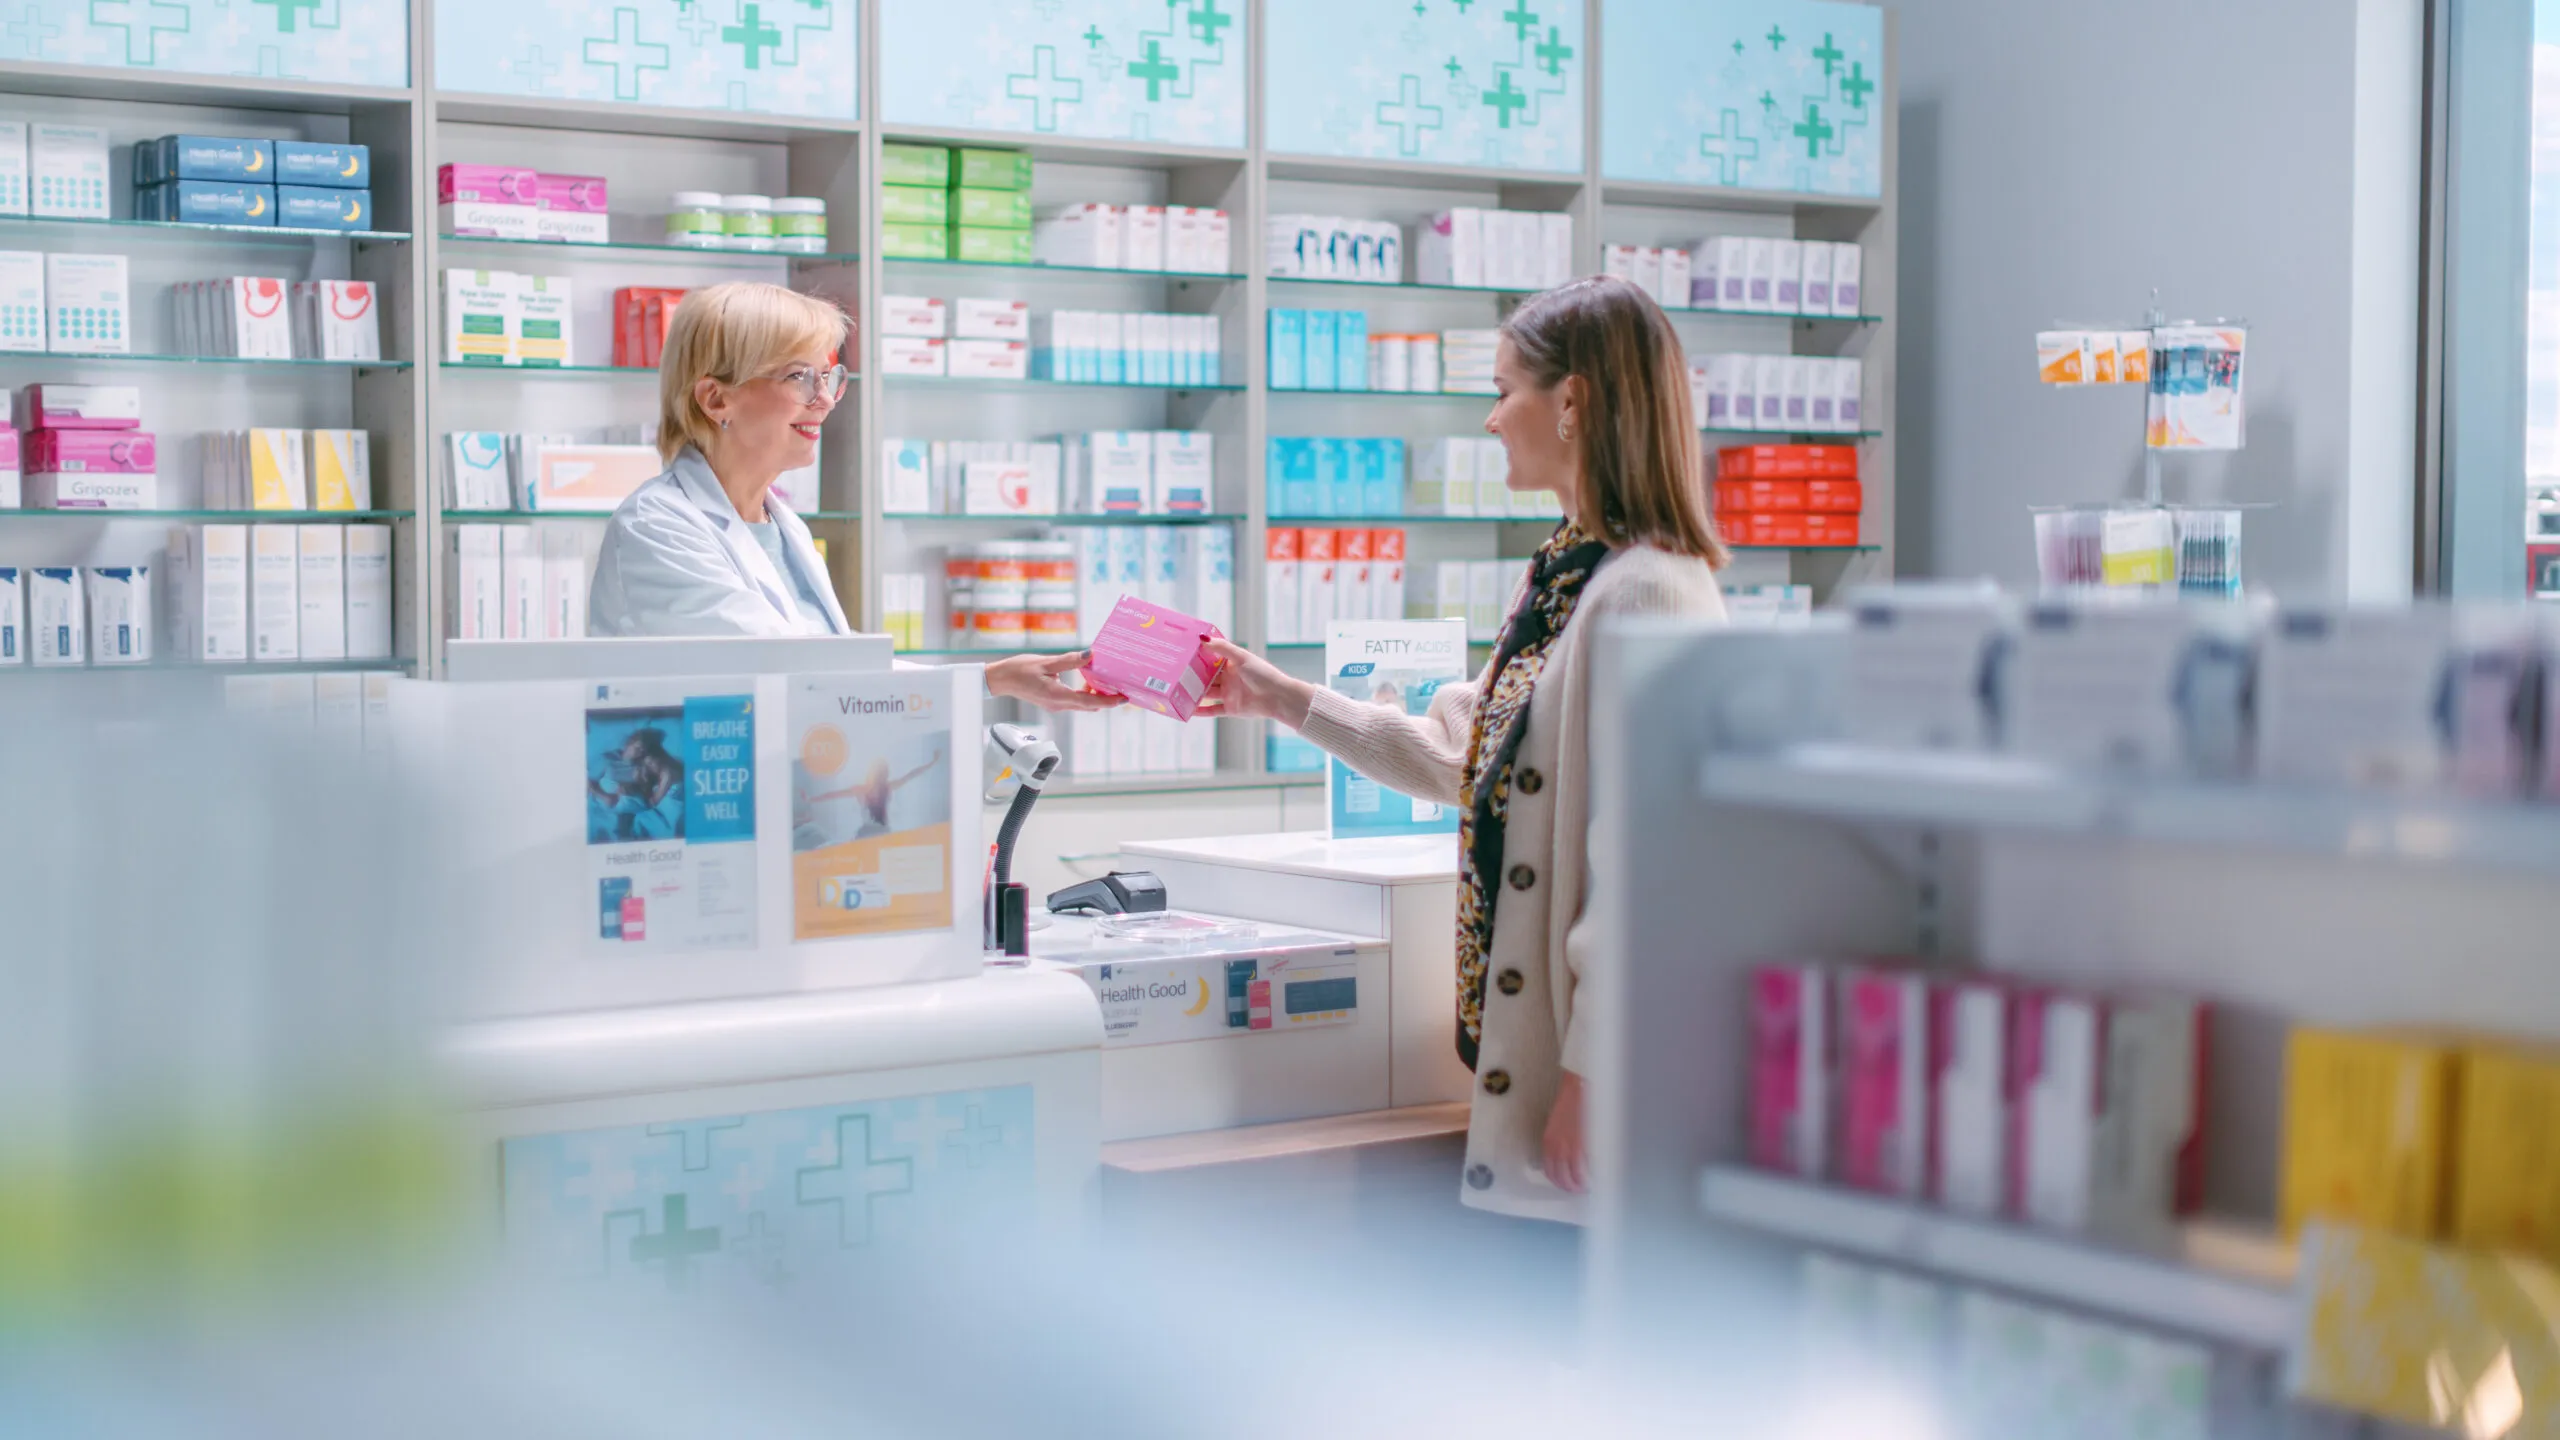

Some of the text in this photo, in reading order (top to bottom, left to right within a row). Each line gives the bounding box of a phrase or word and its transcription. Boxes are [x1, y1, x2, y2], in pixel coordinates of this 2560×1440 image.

[71, 481, 140, 498] Gripozex
[1364, 639, 1452, 654] FATTY ACIDS
[1348, 664, 1368, 674] KIDS
[838, 695, 905, 715] Vitamin
[692, 720, 748, 740] BREATHE
[702, 745, 739, 761] EASILY
[694, 767, 749, 796] SLEEP
[704, 801, 740, 821] WELL
[606, 848, 683, 865] Health Good
[1101, 980, 1187, 1004] Health Good
